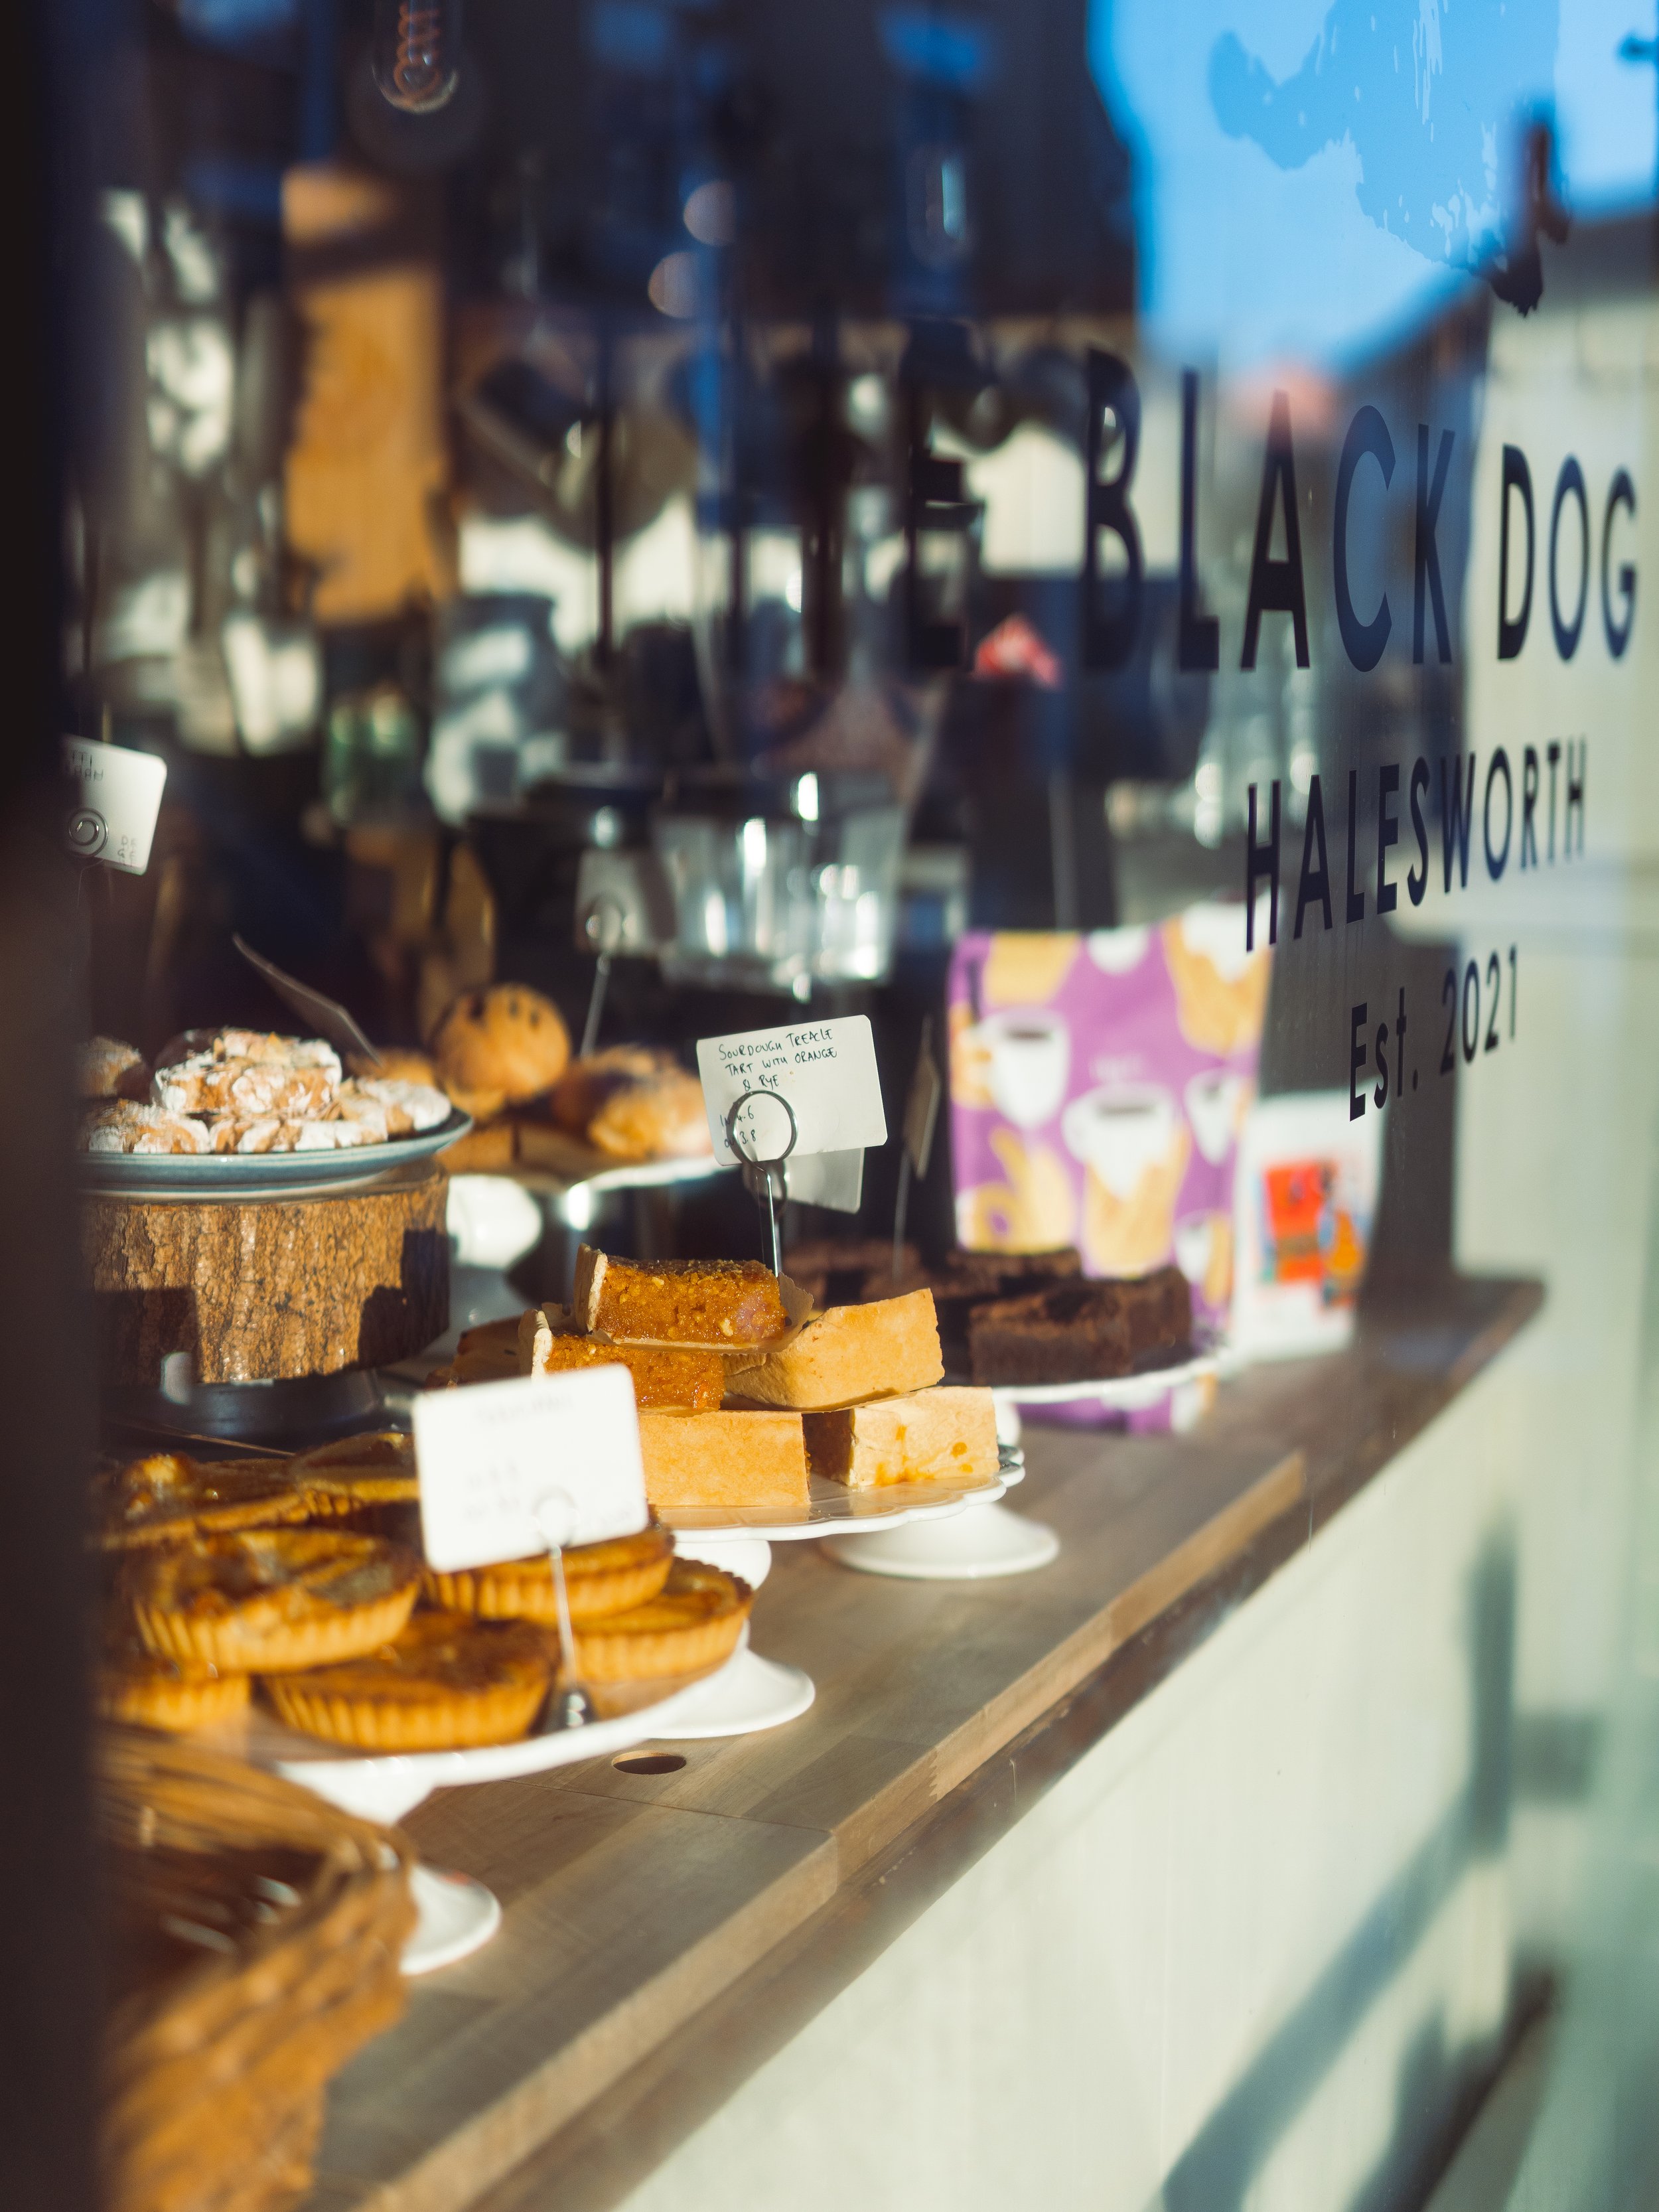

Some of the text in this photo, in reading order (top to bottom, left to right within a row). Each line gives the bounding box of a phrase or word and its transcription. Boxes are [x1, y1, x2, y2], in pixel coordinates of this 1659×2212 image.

[1085, 348, 1455, 673] BLACK
[1497, 443, 1637, 661] DOG
[1246, 735, 1587, 953] HALESWORTH
[719, 1029, 833, 1061] SOURDOUGH TREACLE
[725, 1047, 837, 1077] TART WITH ORANGE
[758, 1074, 779, 1090] RYE
[1350, 943, 1518, 1122] Est. 2021
